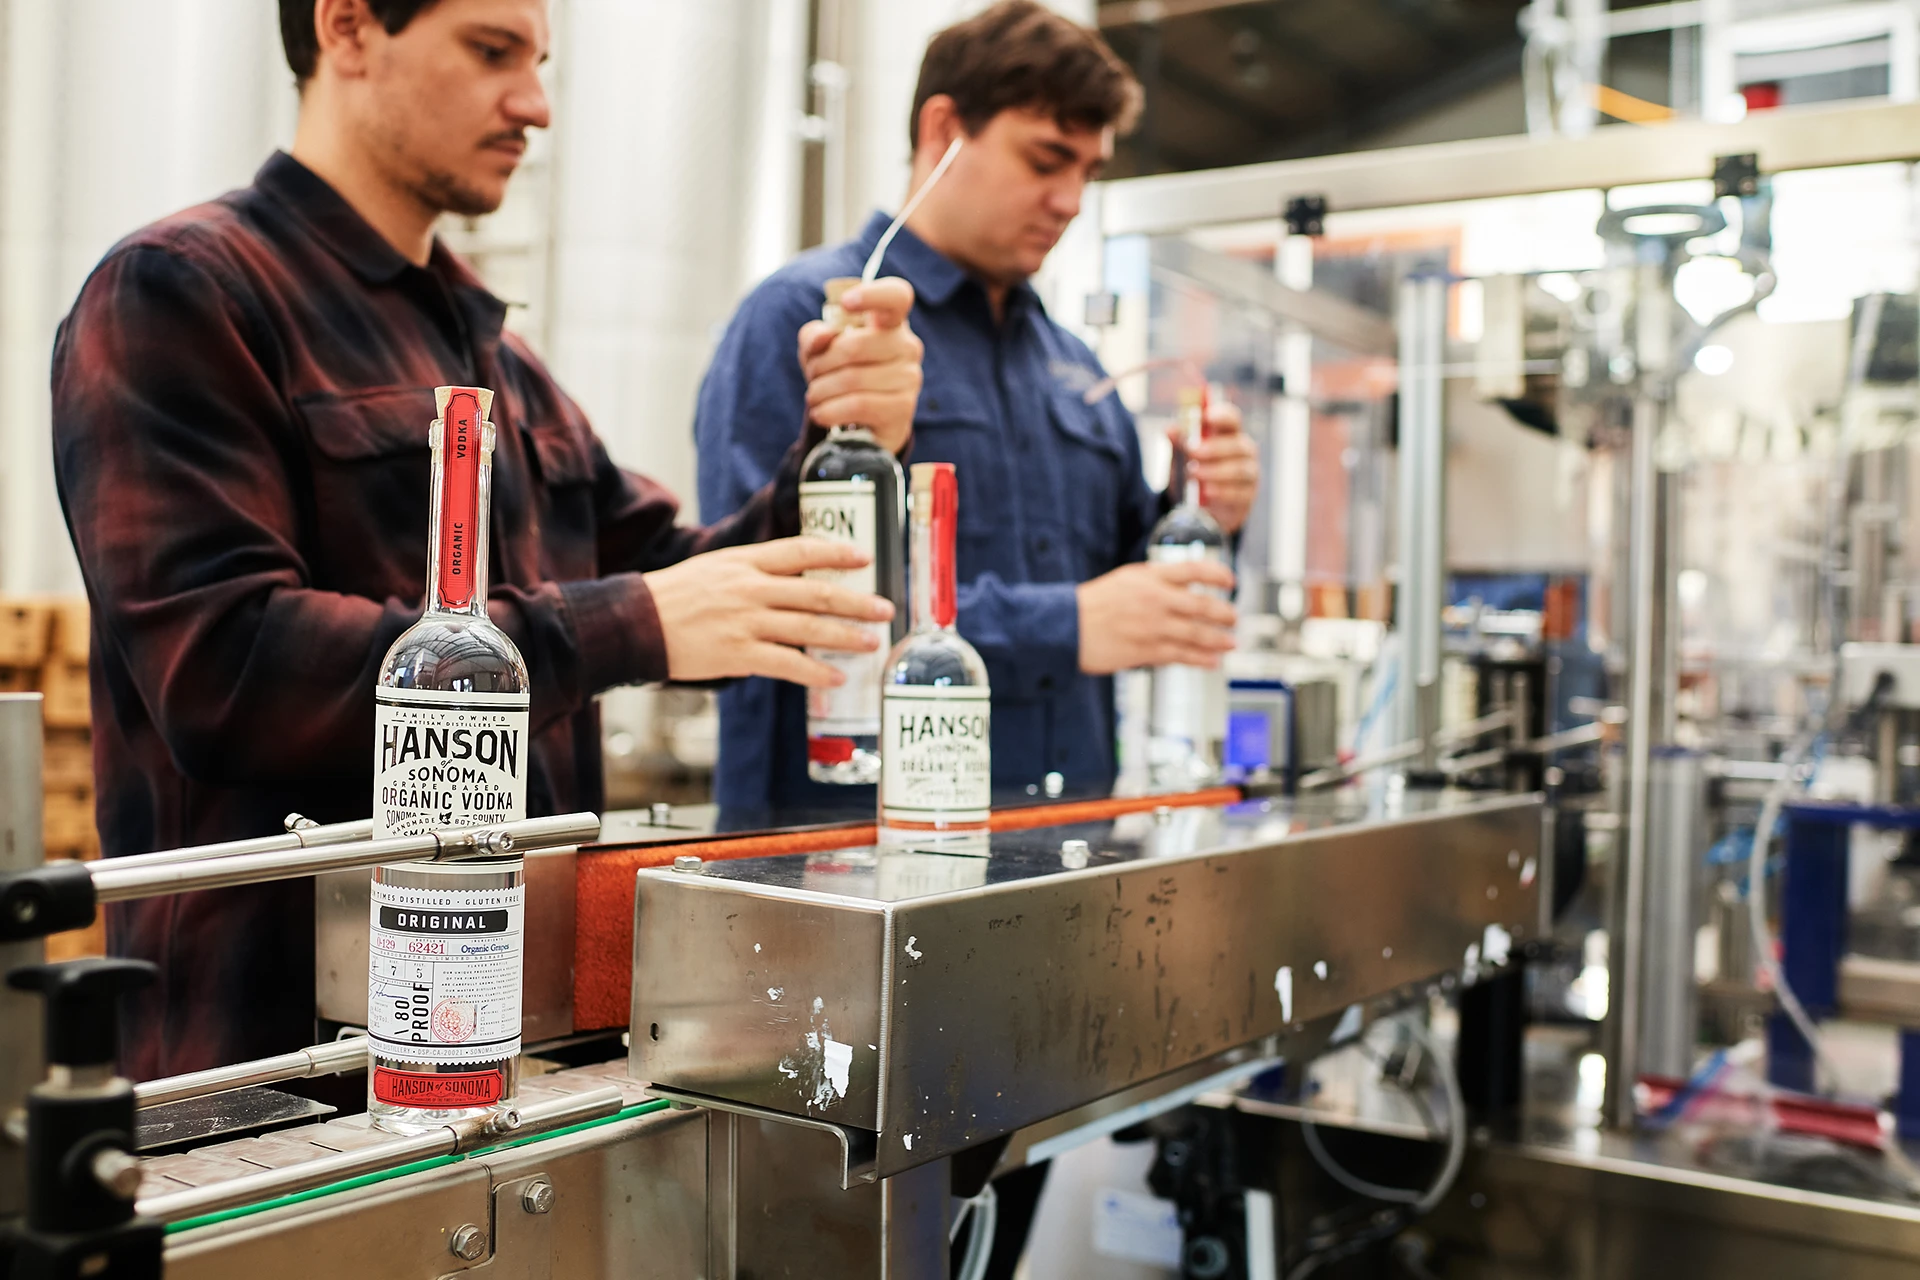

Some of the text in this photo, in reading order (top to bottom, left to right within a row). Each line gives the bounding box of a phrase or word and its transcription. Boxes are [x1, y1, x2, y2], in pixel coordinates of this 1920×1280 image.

[456, 419, 468, 458] VODKA
[452, 522, 463, 575] ORGANIC
[395, 711, 446, 720] FAMILY
[381, 724, 519, 779] HANSON
[408, 766, 487, 784] SONOMA
[393, 780, 437, 790] GRAPE
[382, 786, 513, 811] ORGANIC VODKA
[386, 809, 417, 829] SONOMA
[391, 817, 436, 836] HANDMADE
[399, 895, 451, 906] DISTILLED
[465, 897, 501, 906] GLUTEN
[397, 913, 487, 929] ORIGINAL
[408, 941, 446, 954] 62421
[461, 943, 489, 956] Organic
[411, 982, 430, 1042] PROOF
[391, 1077, 434, 1098] HANSON
[445, 1078, 490, 1098] SONOMA
